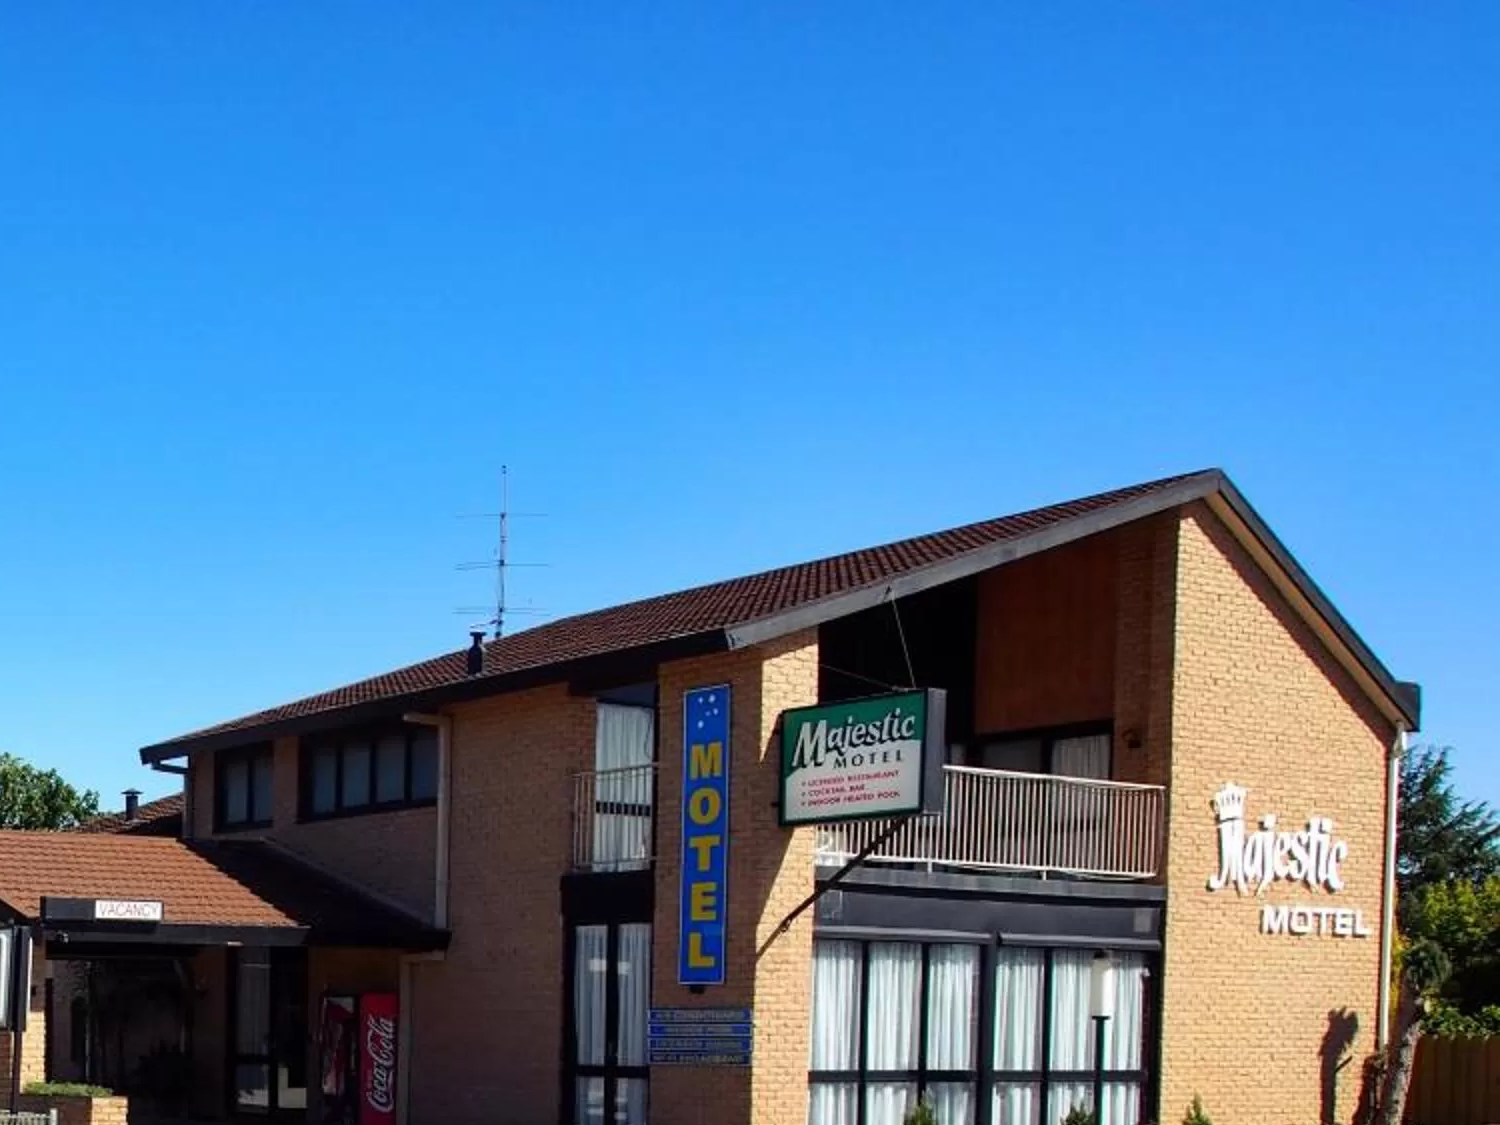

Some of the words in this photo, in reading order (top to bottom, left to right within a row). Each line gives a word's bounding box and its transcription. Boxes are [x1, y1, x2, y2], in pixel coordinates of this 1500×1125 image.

[791, 707, 916, 768] Majestic
[833, 750, 904, 769] MOTEL
[688, 741, 723, 968] MOTEL
[1207, 812, 1349, 897] Majestic
[99, 903, 159, 917] VACANCY
[1260, 904, 1373, 938] MOTEL
